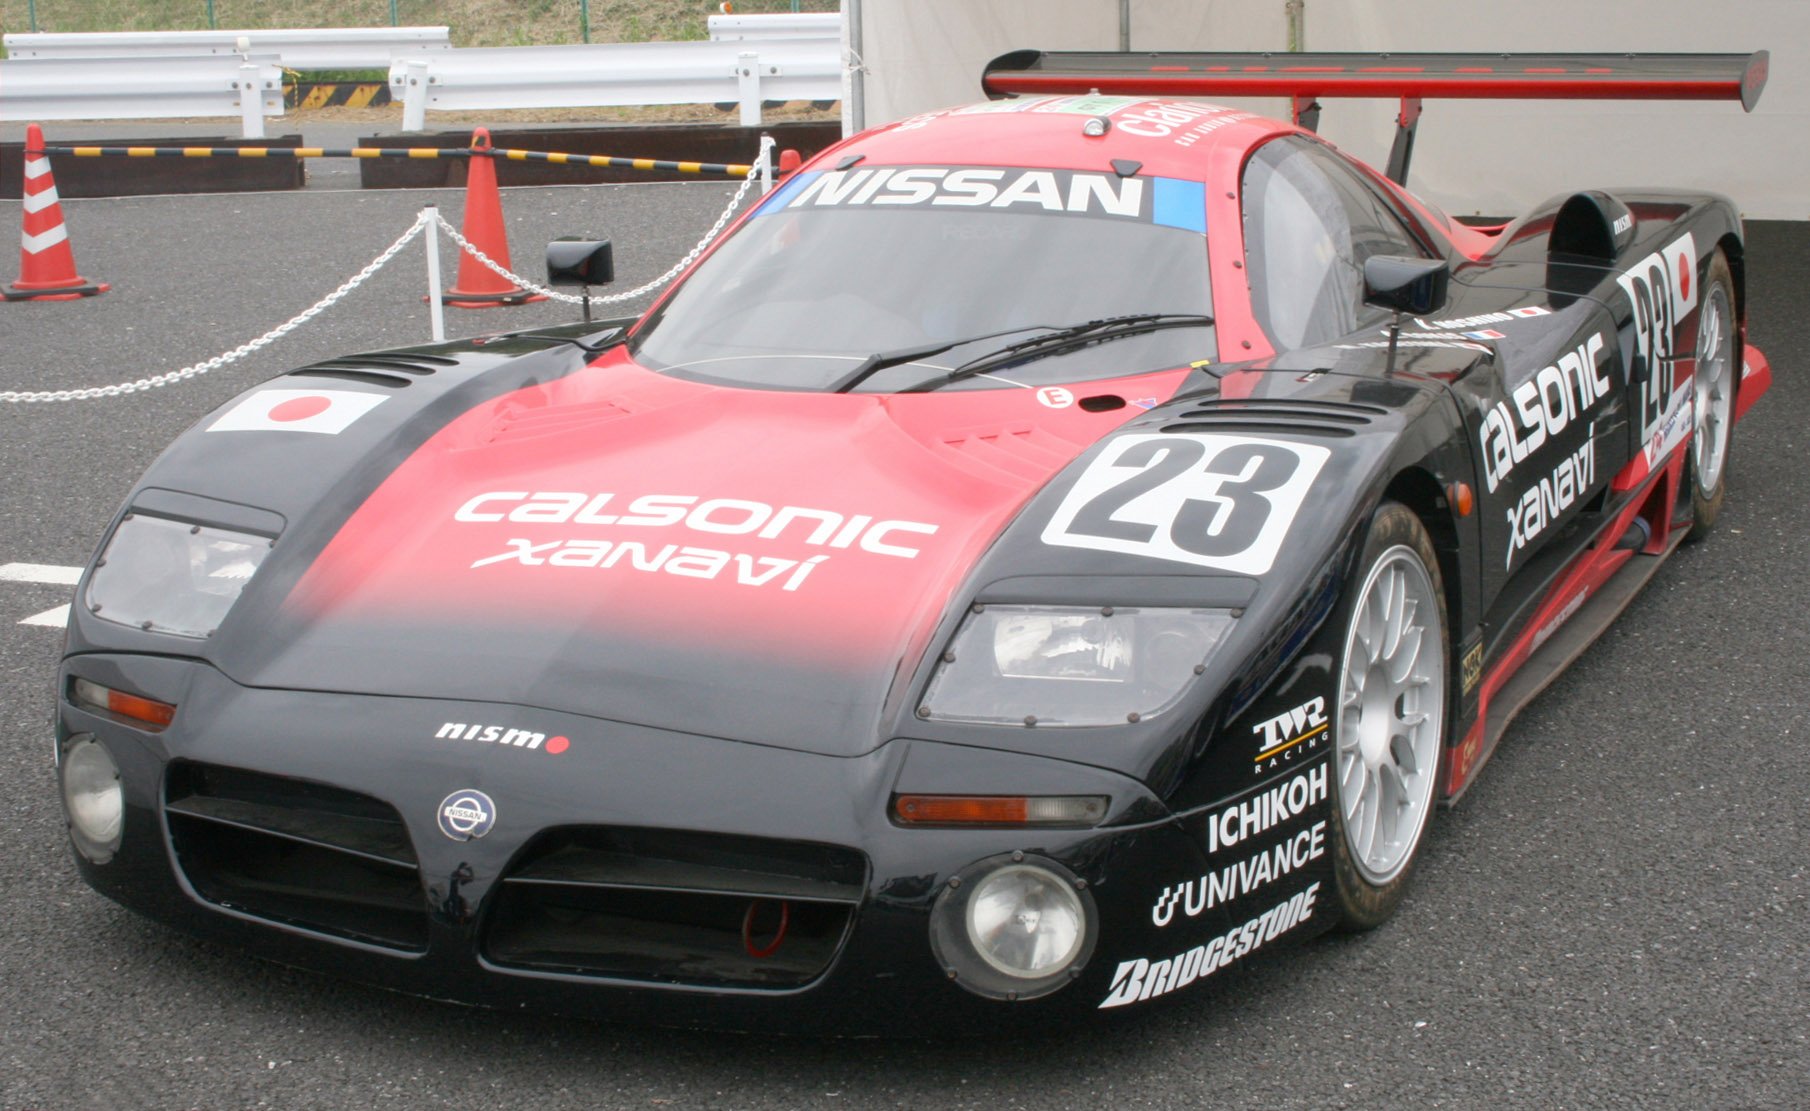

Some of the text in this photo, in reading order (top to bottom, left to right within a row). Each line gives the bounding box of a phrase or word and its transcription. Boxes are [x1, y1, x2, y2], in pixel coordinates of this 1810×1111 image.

[789, 169, 1143, 217] NISSAN
[1064, 438, 1301, 557] 23
[1253, 696, 1329, 752] TWR
[1255, 731, 1329, 773] RACING
[448, 808, 483, 821] NISSAN
[1209, 762, 1328, 853] ICHIKOH
[1184, 821, 1326, 917] UNIVANCE
[1097, 881, 1320, 1009] BRIDGESTONE
